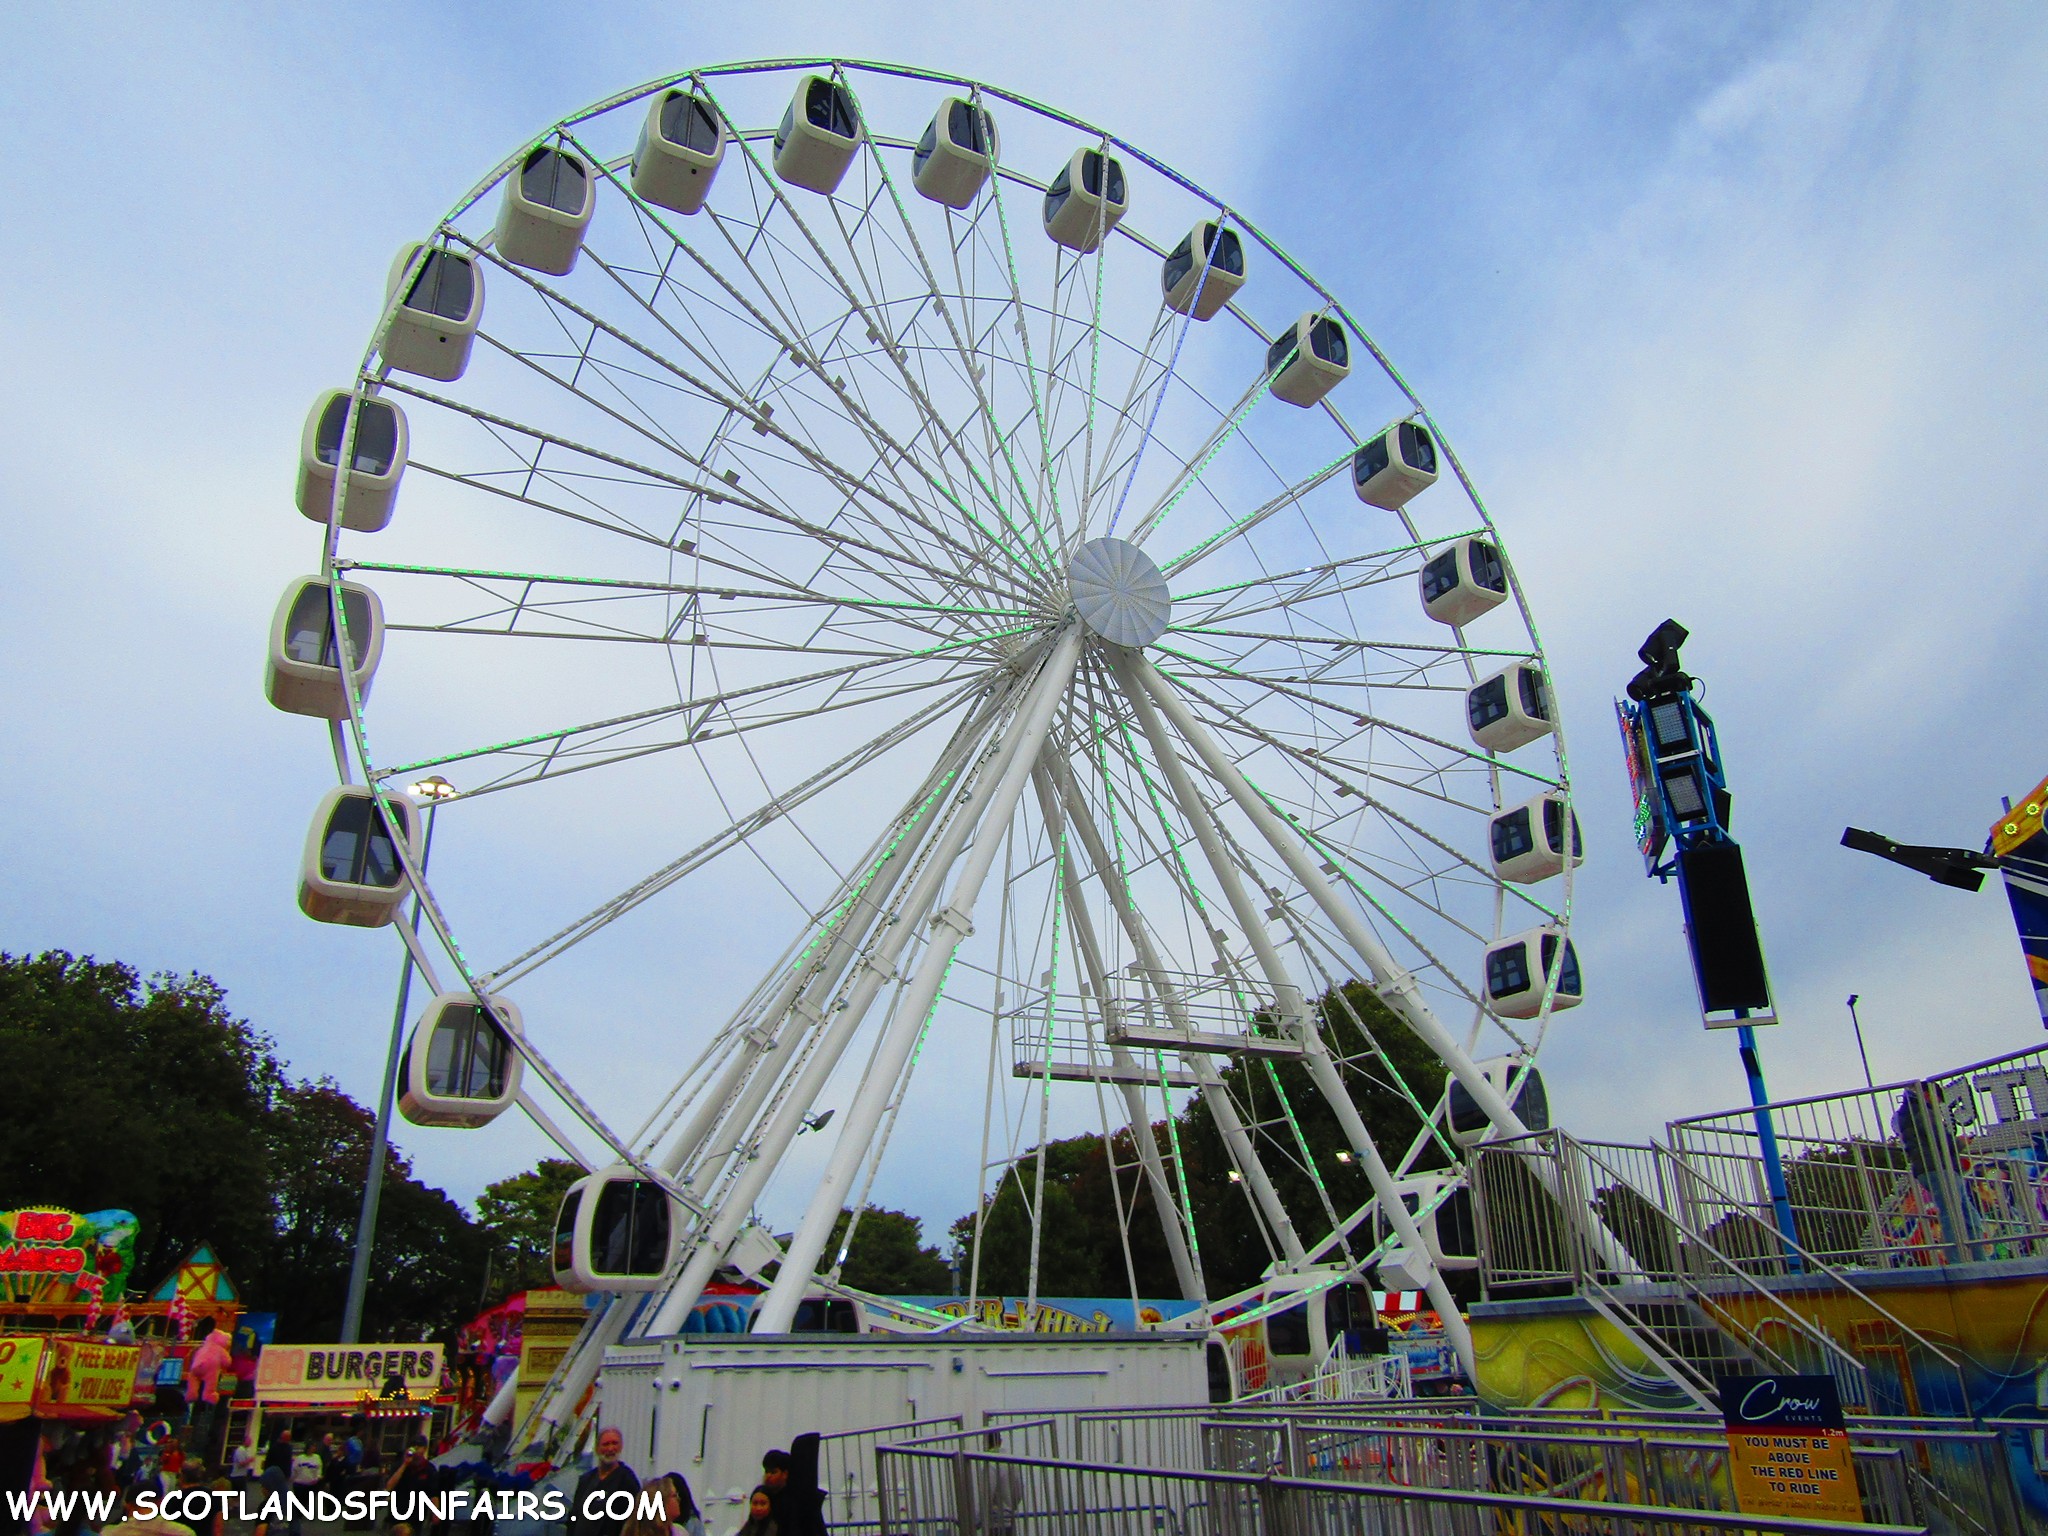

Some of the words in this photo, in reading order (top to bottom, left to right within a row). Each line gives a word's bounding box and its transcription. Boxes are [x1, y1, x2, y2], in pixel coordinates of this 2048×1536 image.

[14, 1211, 74, 1241] BIG
[306, 1351, 434, 1380] BURGERS
[1740, 1379, 1820, 1420] Crow
[1822, 1428, 1844, 1437] 1.2m
[1744, 1437, 1769, 1447] YOU
[1773, 1438, 1807, 1449] MUST
[1812, 1439, 1829, 1449] BE
[1768, 1453, 1810, 1464] ABOVE
[1751, 1466, 1775, 1477] THE
[1779, 1468, 1804, 1478] RED
[1808, 1469, 1838, 1480] LINE
[1769, 1482, 1785, 1493] TO
[1790, 1483, 1820, 1495] RIDE
